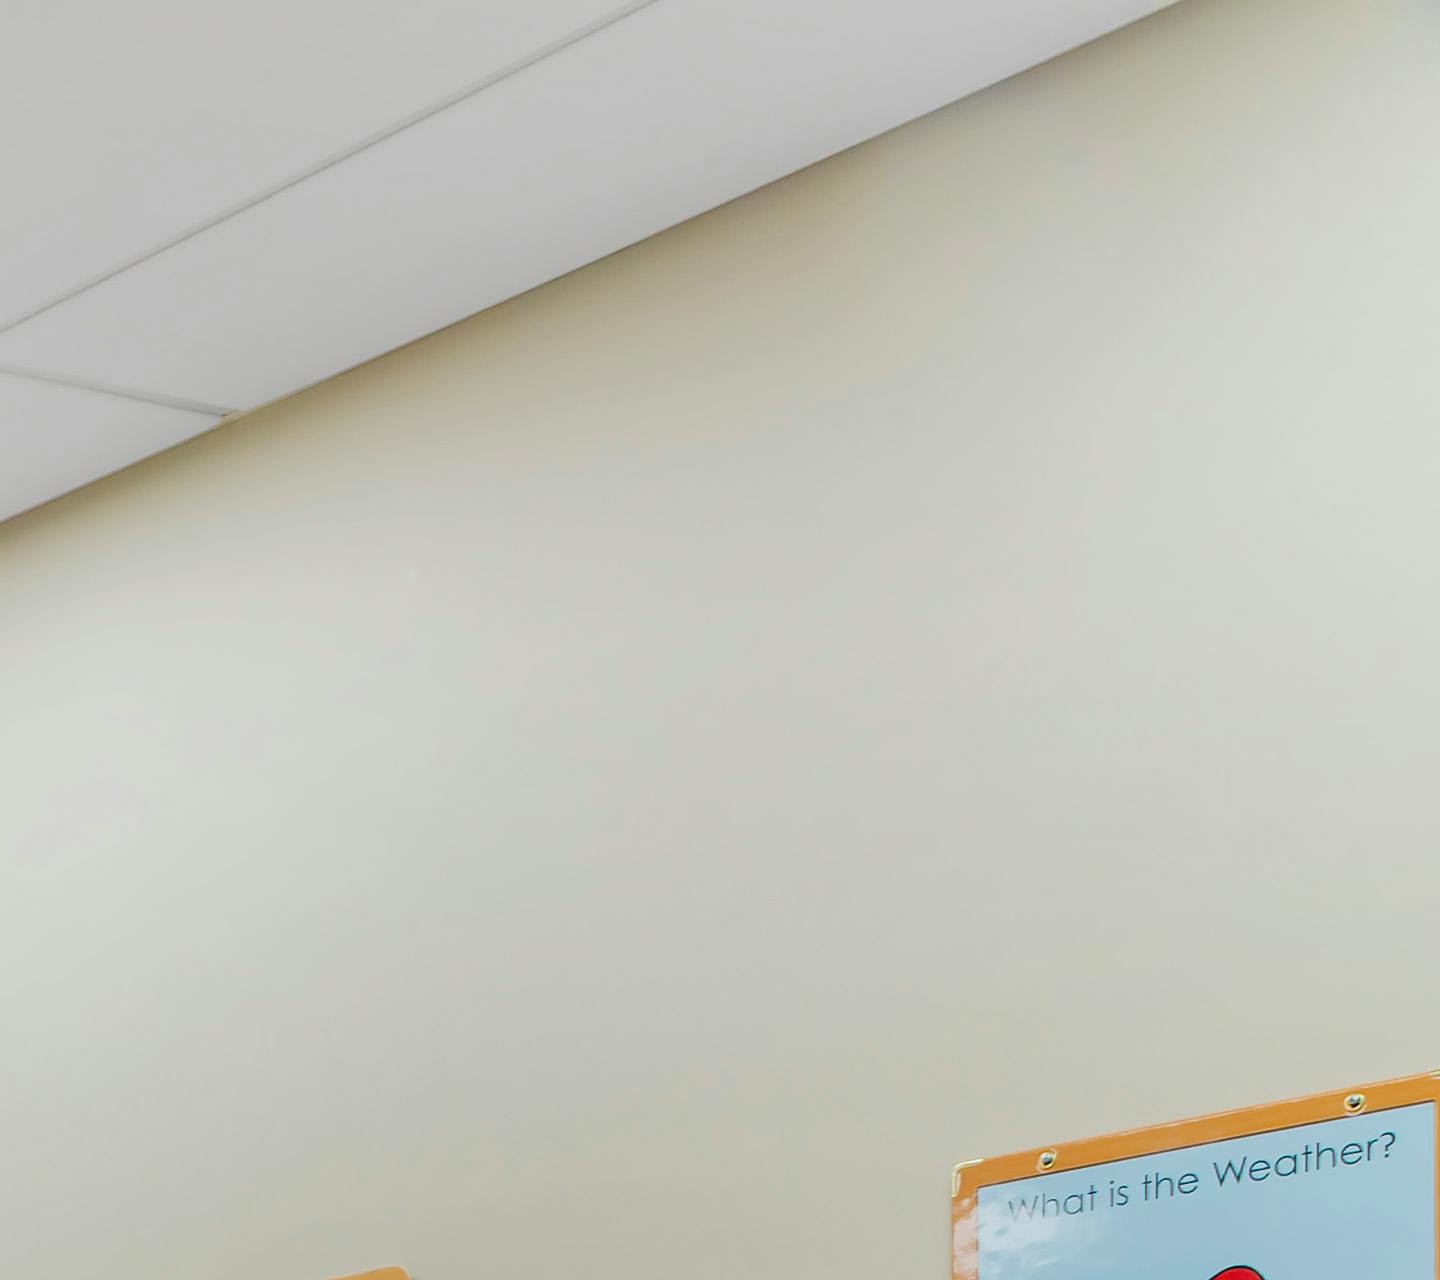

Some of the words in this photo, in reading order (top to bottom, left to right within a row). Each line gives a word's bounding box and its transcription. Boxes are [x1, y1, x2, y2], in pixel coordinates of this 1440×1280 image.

[1007, 1184, 1098, 1223] What
[1108, 1180, 1129, 1208] is
[1141, 1172, 1200, 1201] the
[1213, 1131, 1397, 1187] Weather?
